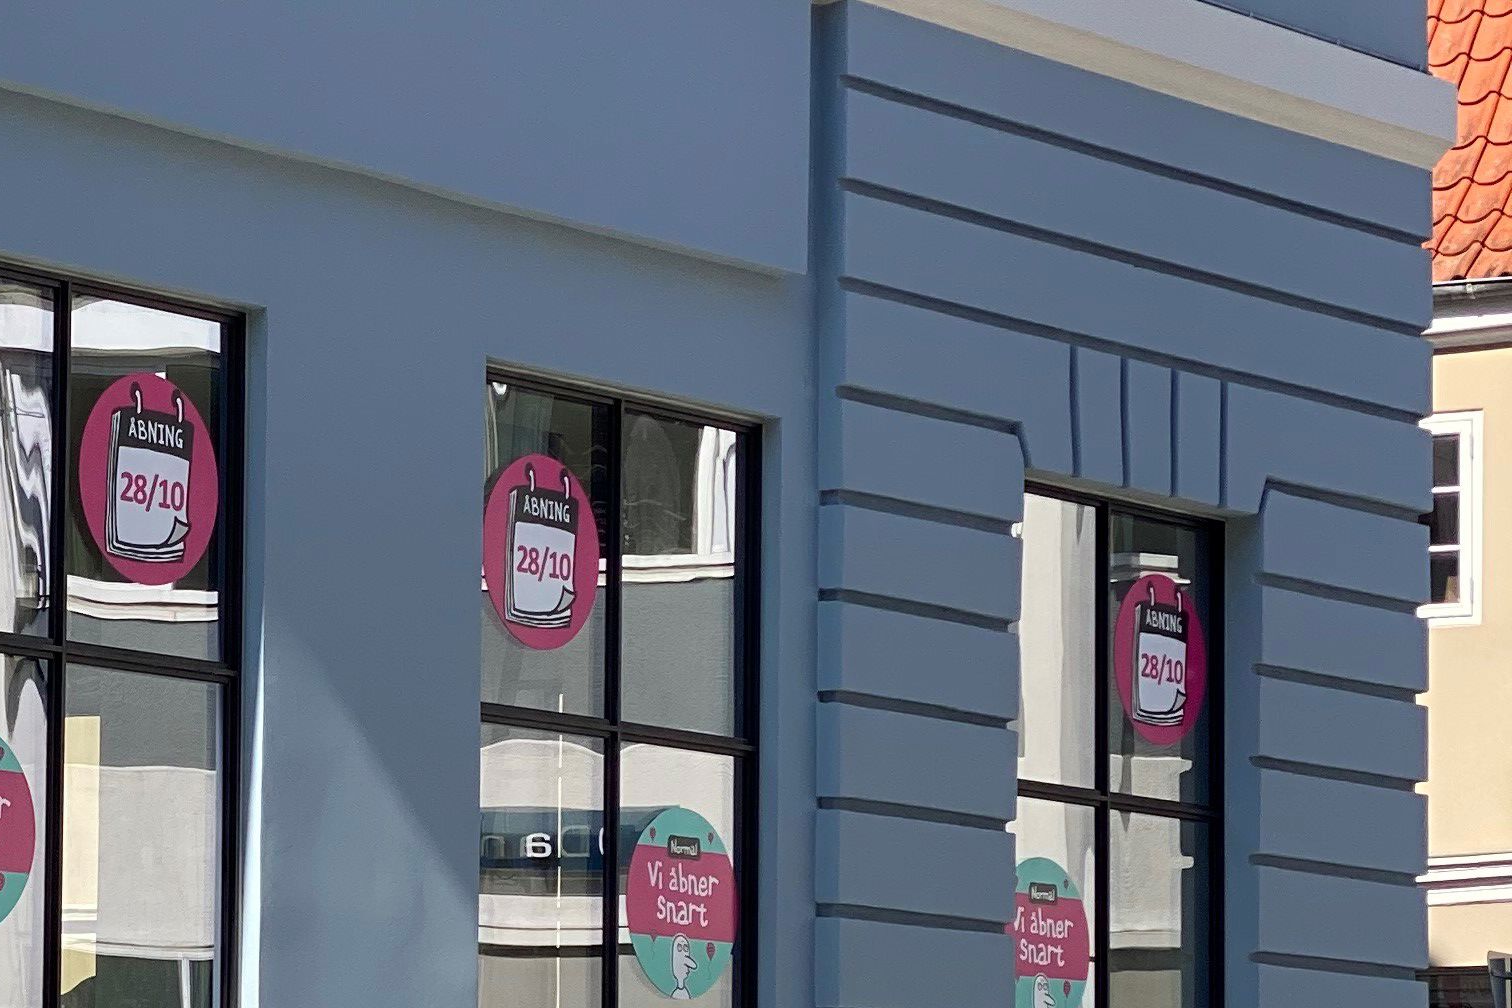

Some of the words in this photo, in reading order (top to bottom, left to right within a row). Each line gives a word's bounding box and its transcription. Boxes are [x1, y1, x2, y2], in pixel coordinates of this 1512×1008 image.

[128, 416, 184, 449] ÅBNING
[120, 471, 185, 512] 28/10
[523, 494, 571, 524] ÅBNING
[517, 545, 572, 583] 28/10
[1145, 608, 1183, 634] ÅBNING
[1140, 652, 1184, 686] 28/10
[670, 838, 699, 857] Normal
[647, 860, 664, 890] Vi
[669, 863, 720, 897] åbner
[1030, 907, 1074, 939] åbner
